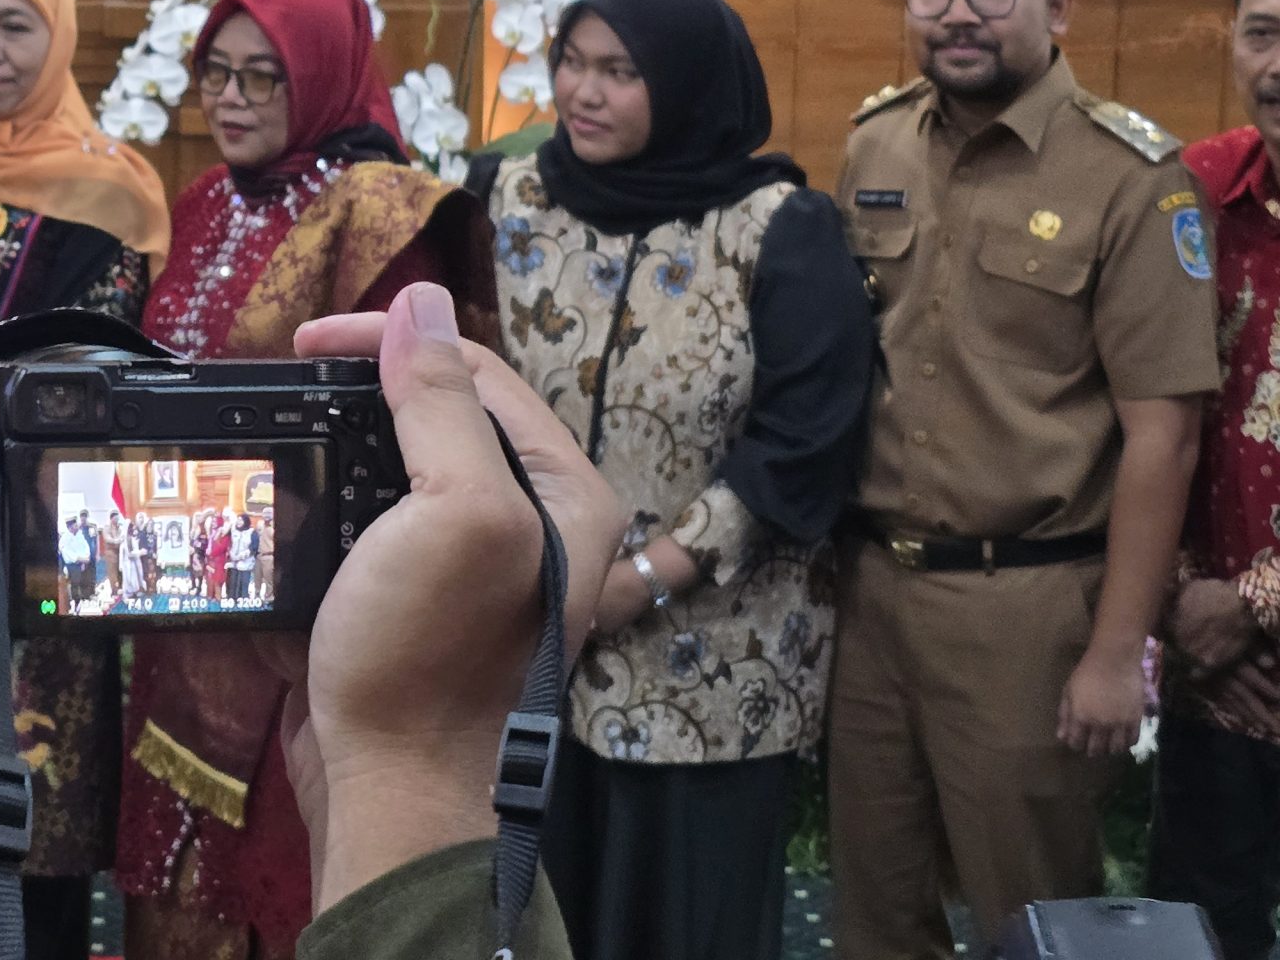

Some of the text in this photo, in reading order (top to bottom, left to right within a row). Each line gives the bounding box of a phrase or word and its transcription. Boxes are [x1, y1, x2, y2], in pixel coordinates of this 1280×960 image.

[303, 392, 332, 402] AF/MF
[274, 412, 303, 423] MENU
[311, 422, 331, 433] AEL
[353, 466, 368, 477] Fn
[375, 488, 398, 499] DISP
[236, 597, 263, 608] 3200
